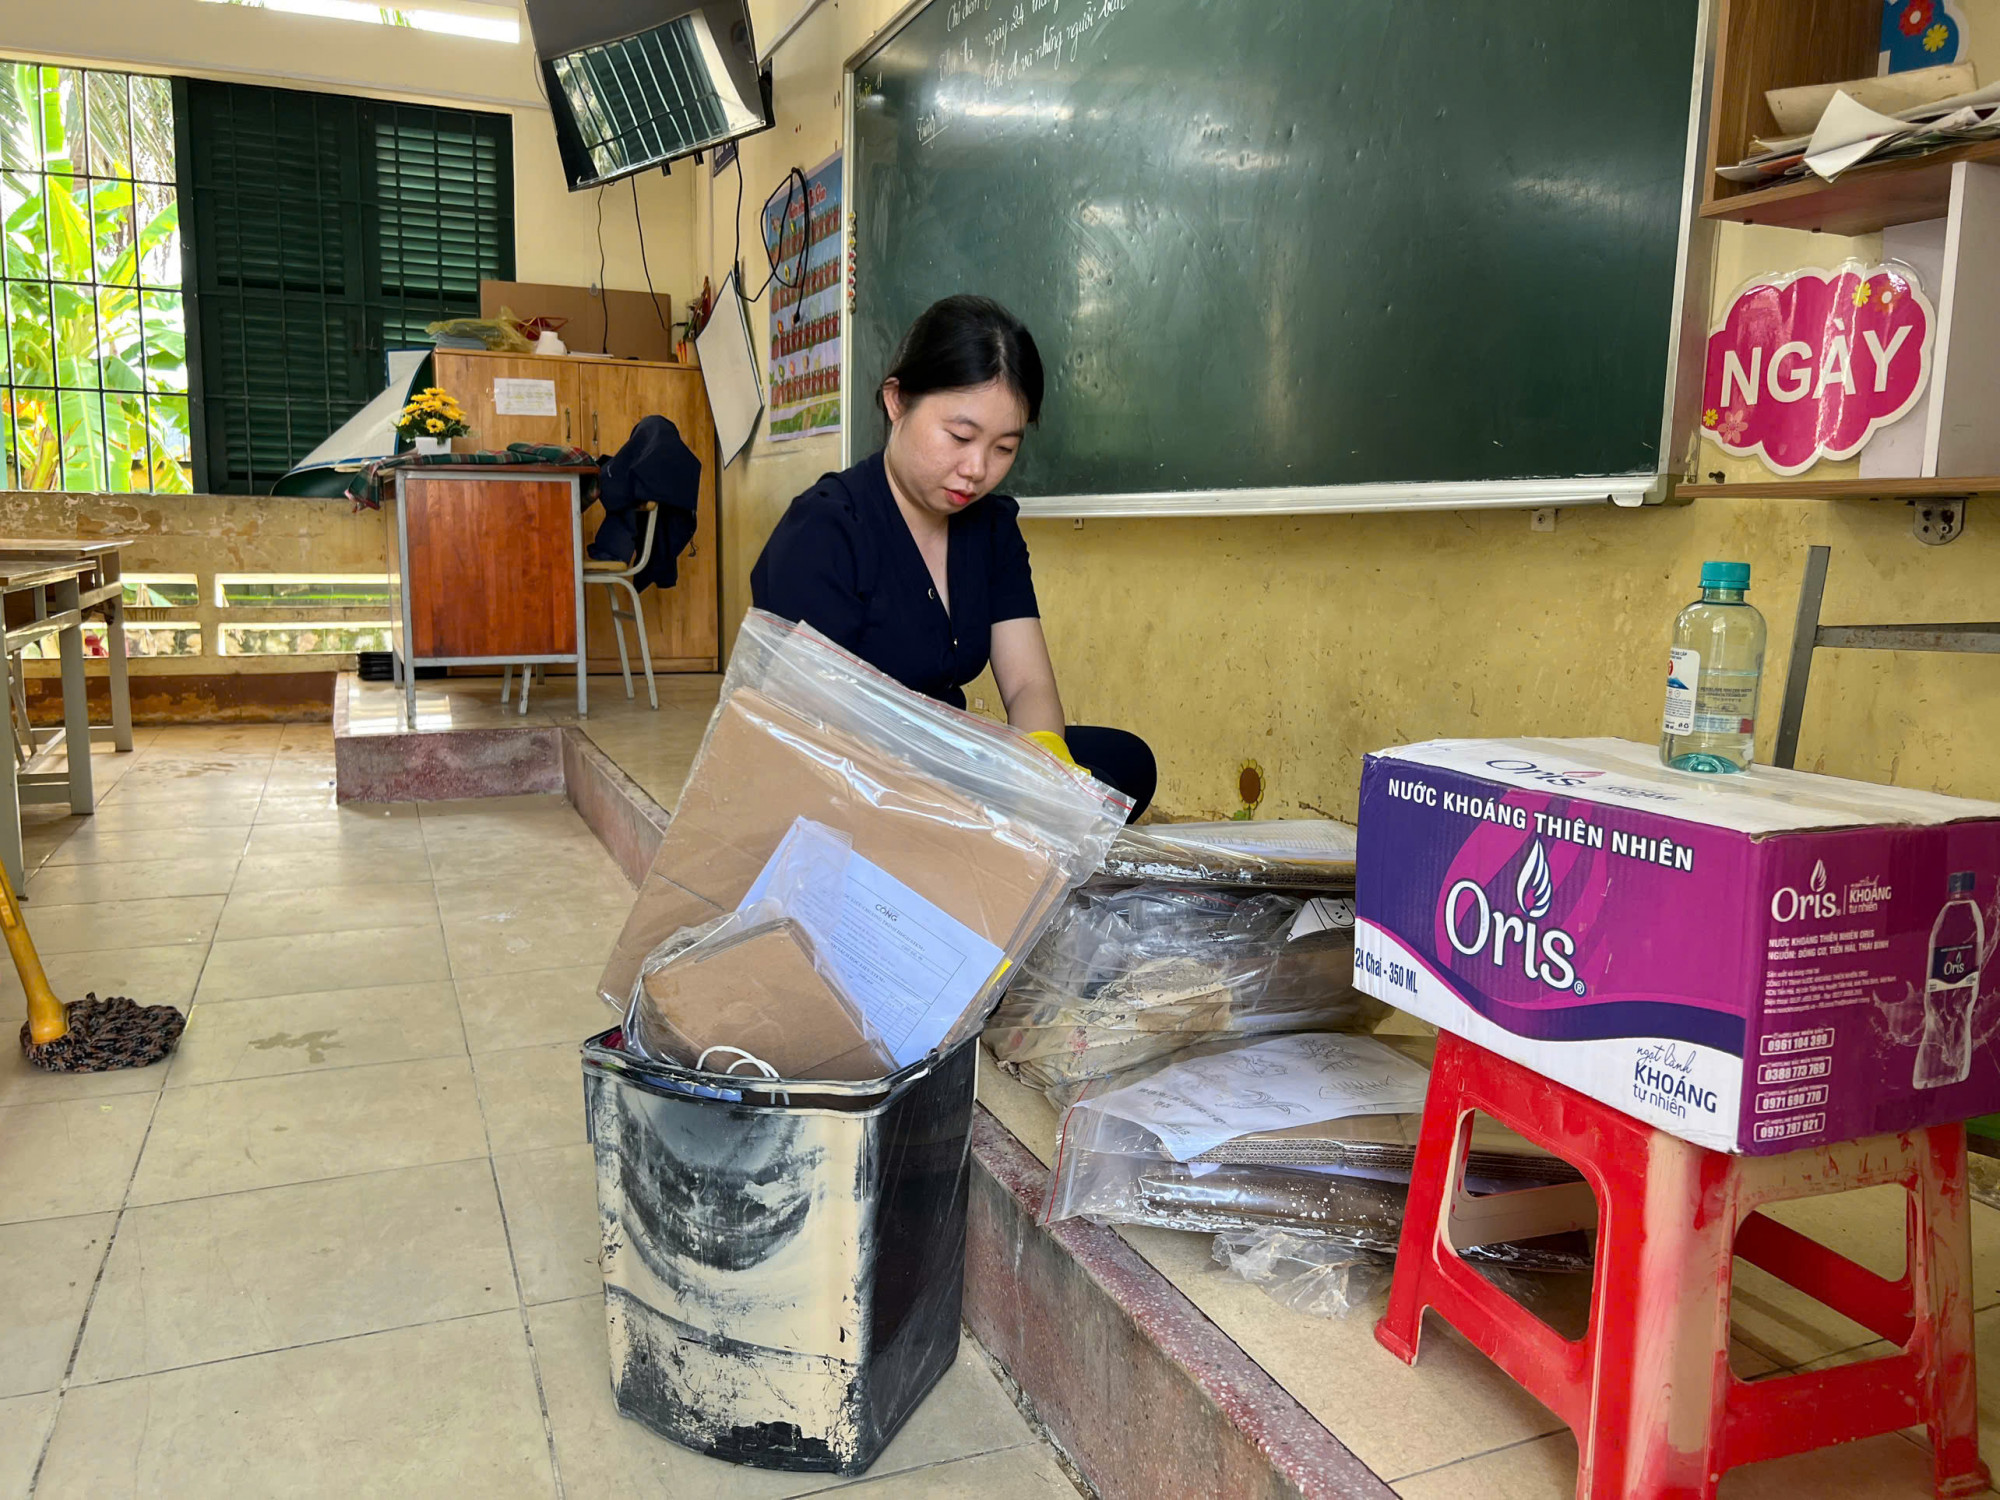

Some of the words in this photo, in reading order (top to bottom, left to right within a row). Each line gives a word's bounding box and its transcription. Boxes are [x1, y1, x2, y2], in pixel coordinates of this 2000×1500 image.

[1035, 25, 1063, 71] những
[1066, 1, 1097, 62] người
[1720, 318, 1913, 407] NGÀY
[1388, 778, 1437, 807] NƯỚC
[1443, 791, 1527, 830] KHOÁNG
[1534, 812, 1603, 849] THIÊN
[1612, 830, 1694, 872] NHIÊN
[1771, 887, 1837, 922] Oris
[1849, 886, 1892, 903] KHOÁNG
[1445, 878, 1576, 989] Oris
[1355, 947, 1364, 970] 24
[1365, 951, 1382, 978] Chai
[1389, 961, 1404, 987] 350
[1406, 968, 1418, 994] ML
[1944, 961, 1965, 976] Oris
[1636, 1045, 1665, 1067] ngọt
[1663, 1043, 1697, 1074] lành
[1768, 1039, 1792, 1052] 0961
[1794, 1036, 1809, 1049] 104
[1810, 1034, 1828, 1047] 399
[1634, 1061, 1718, 1113] KHOÁNG
[1765, 1067, 1791, 1081] 0388
[1792, 1065, 1808, 1078] 773
[1809, 1062, 1826, 1075] 769
[1633, 1083, 1648, 1103] tự
[1649, 1092, 1686, 1119] nhiên
[1762, 1096, 1786, 1110] 0971
[1787, 1093, 1805, 1107] 690
[1806, 1090, 1822, 1103] 770
[1760, 1125, 1785, 1139] 0973
[1786, 1121, 1802, 1135] 797
[1802, 1118, 1819, 1132] 921
